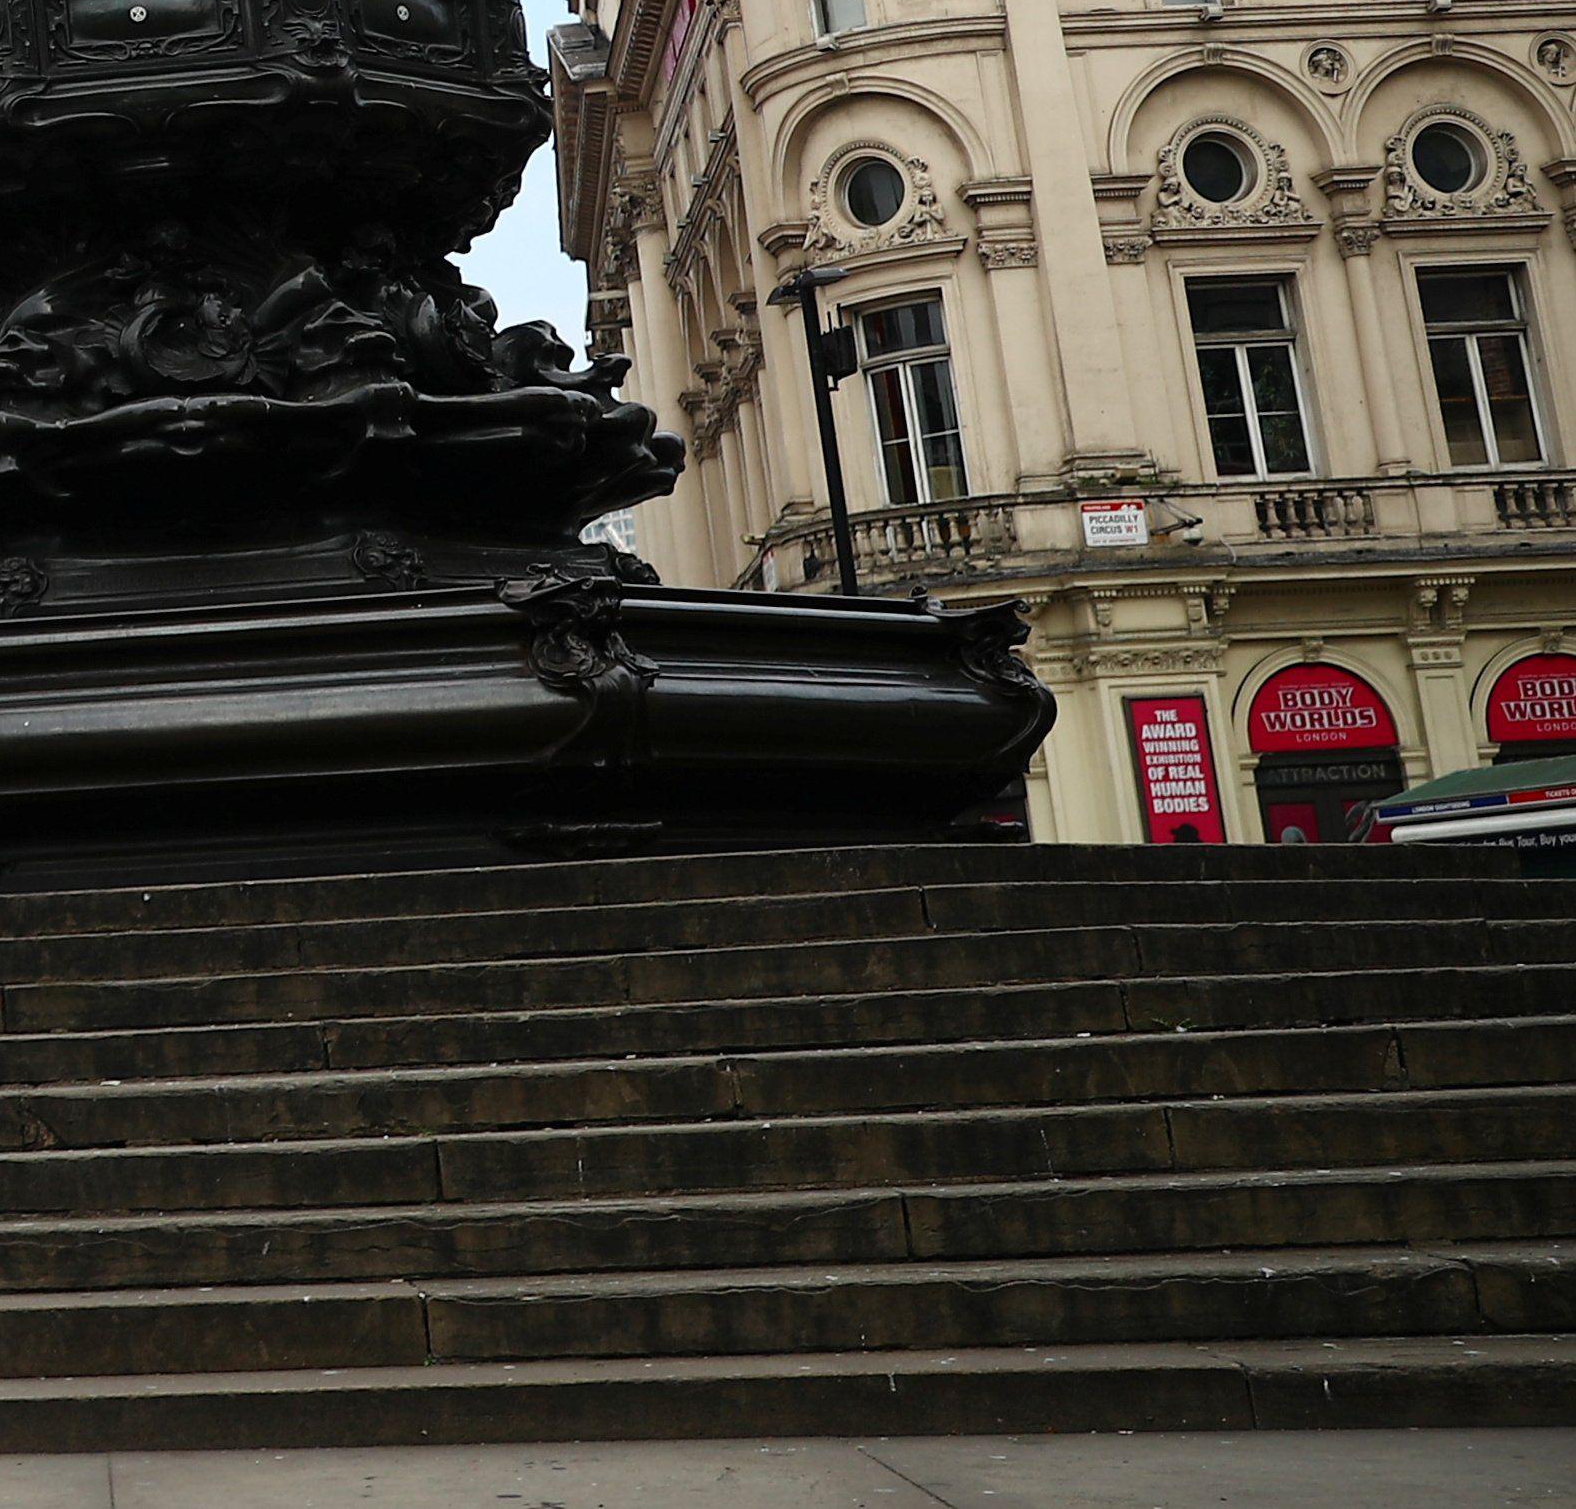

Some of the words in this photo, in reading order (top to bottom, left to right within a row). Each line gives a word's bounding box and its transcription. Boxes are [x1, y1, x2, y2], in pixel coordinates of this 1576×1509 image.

[1088, 514, 1139, 525] PICCADILLY
[1090, 525, 1123, 536] CIRCUS
[1278, 687, 1354, 711] BODY
[1154, 709, 1179, 723] THE
[1260, 707, 1377, 733] WORLDS
[1140, 722, 1197, 740] AWARD
[1296, 731, 1347, 743] LONDON
[1142, 740, 1200, 754] WINNING
[1145, 753, 1202, 766] EXHIBITION
[1147, 766, 1166, 781] OF
[1168, 765, 1204, 780] REAL
[1266, 763, 1386, 785] ATTRACTION
[1150, 780, 1206, 798] HUMAN
[1152, 796, 1210, 814] BODIES
